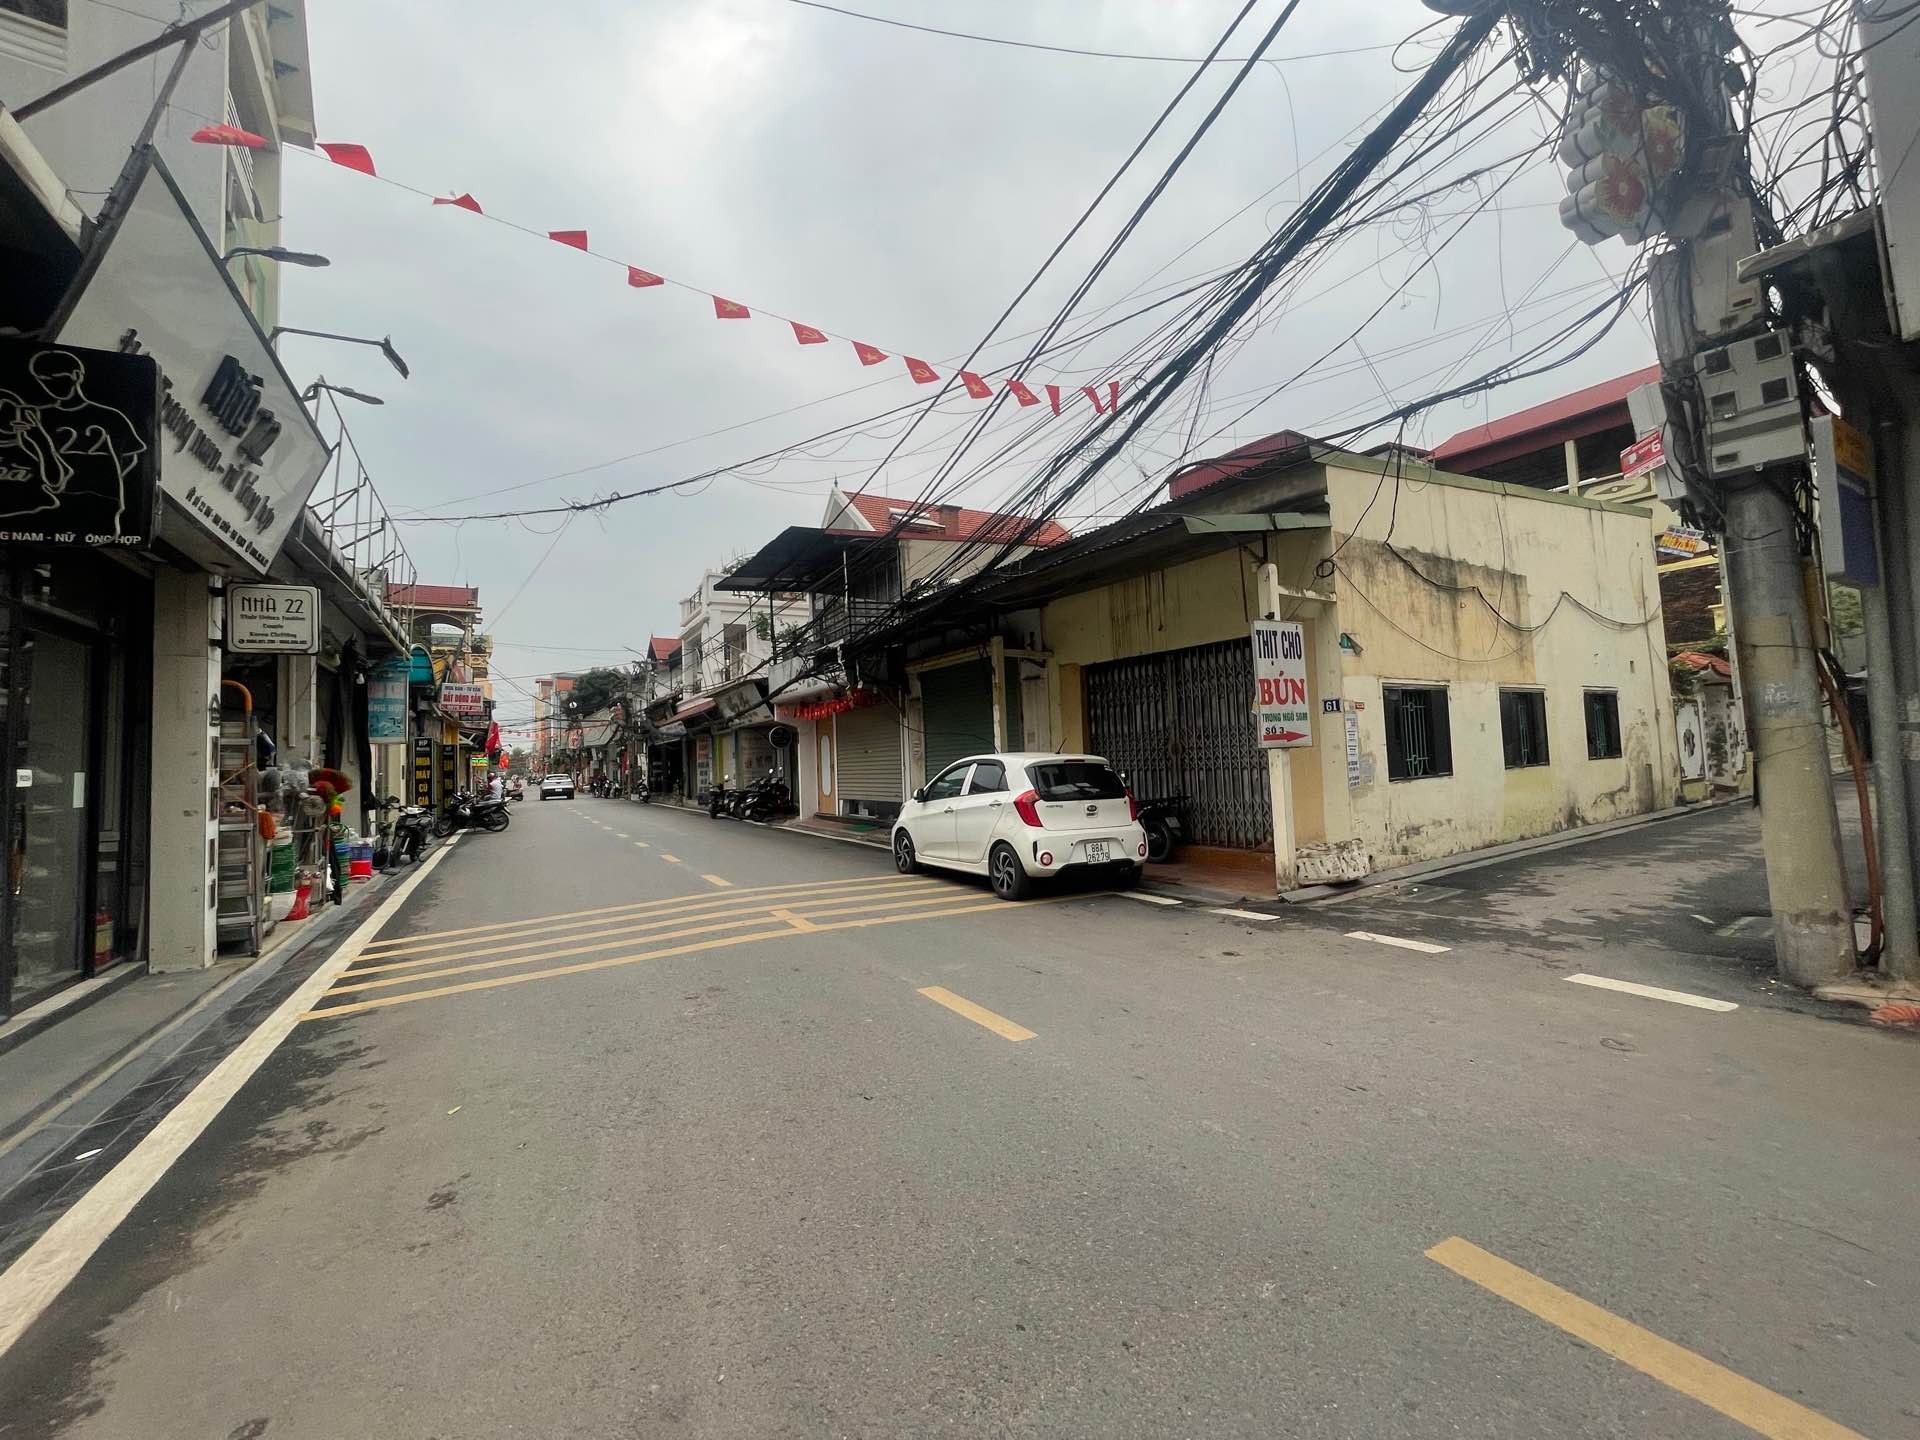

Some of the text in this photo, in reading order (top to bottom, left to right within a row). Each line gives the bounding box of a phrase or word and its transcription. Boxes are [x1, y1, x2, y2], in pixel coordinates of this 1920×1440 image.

[12, 532, 44, 542] NAM
[54, 531, 75, 543] NỮ
[241, 594, 304, 614] NHÀ 22
[1255, 625, 1303, 666] THỊT CHÓ
[1258, 670, 1306, 706] BÚN
[1325, 700, 1338, 711] 61
[1262, 713, 1282, 722] TRONG
[1279, 726, 1285, 734] 3
